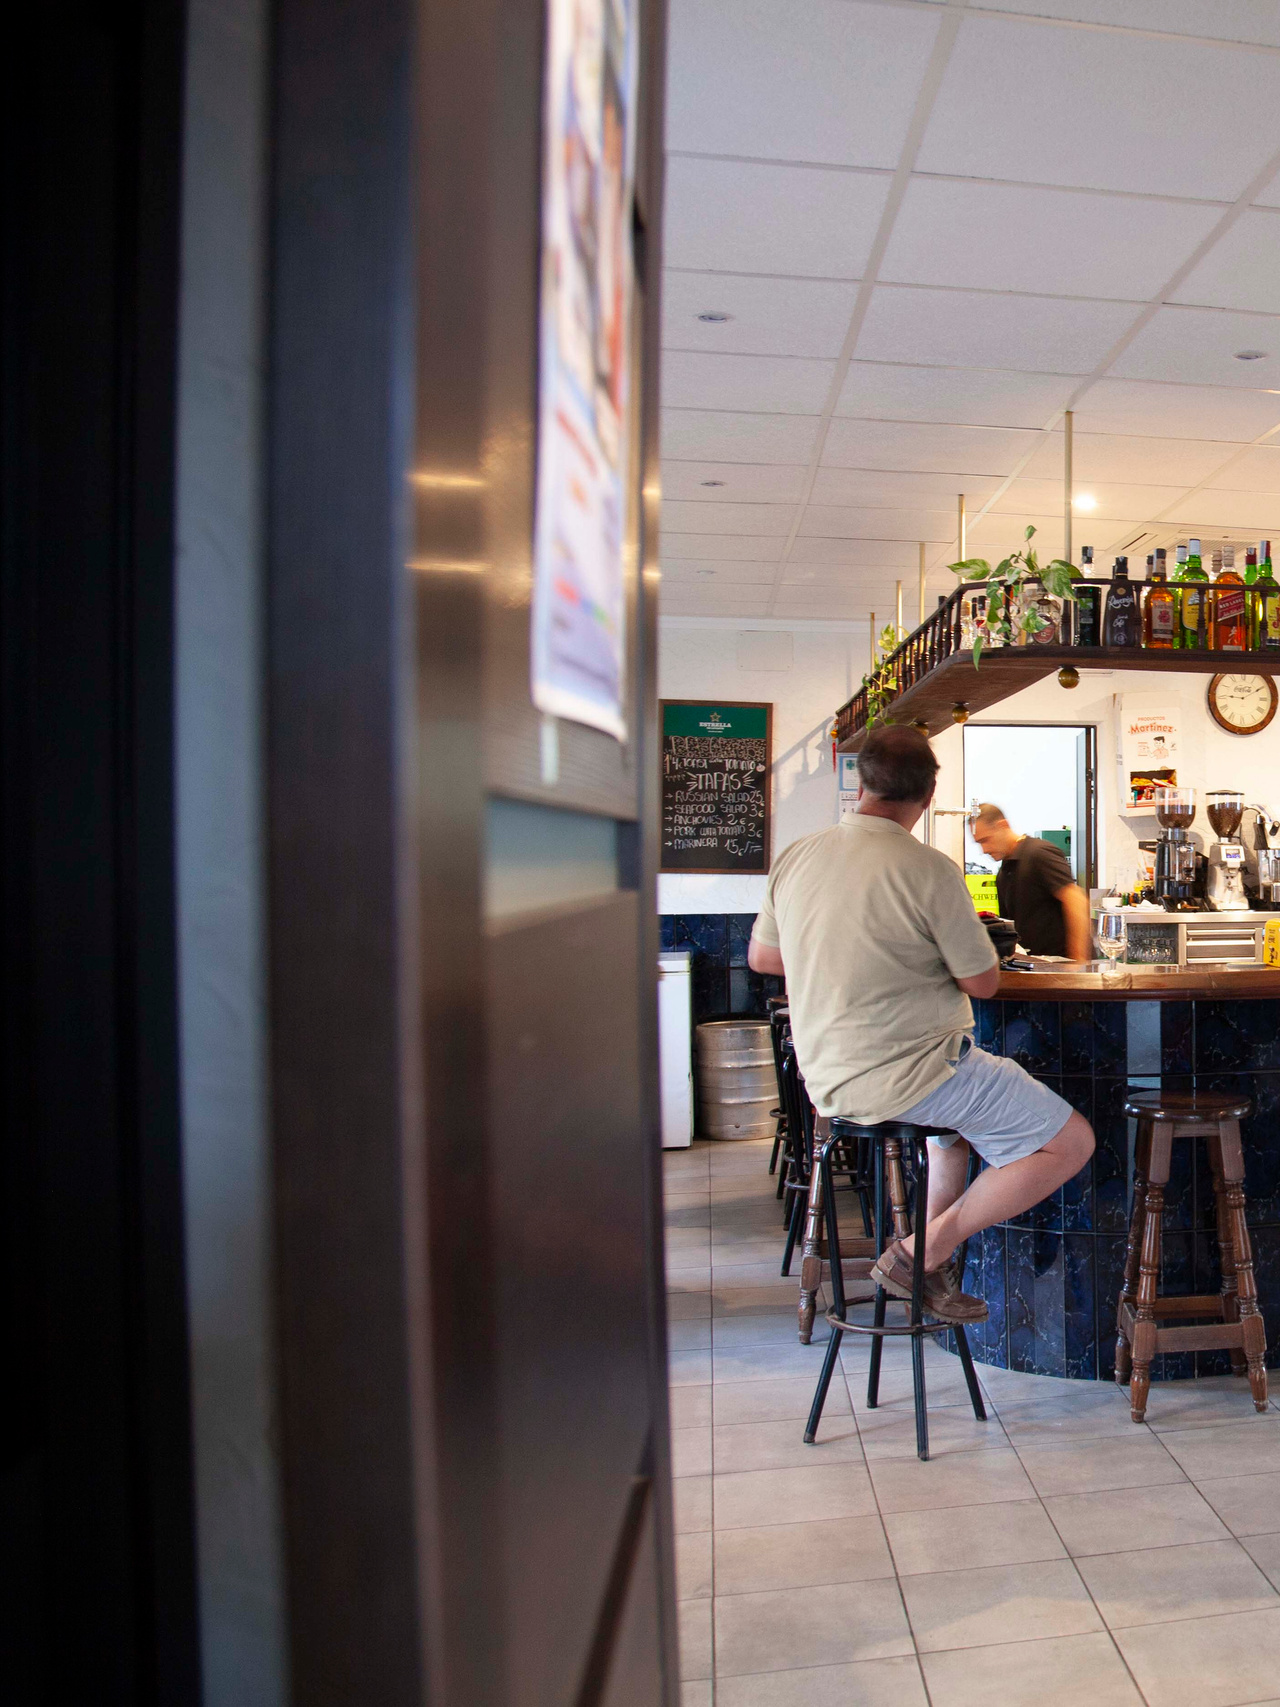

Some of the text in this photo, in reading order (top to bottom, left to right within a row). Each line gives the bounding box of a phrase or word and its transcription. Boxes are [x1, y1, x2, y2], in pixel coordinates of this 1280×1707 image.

[695, 771, 742, 792] TAPAS
[675, 790, 719, 803] RUSSIAN
[721, 792, 750, 803] SALAD
[674, 803, 716, 815] SEAFOOD
[720, 804, 748, 814] SALAD
[674, 814, 722, 825] ANCHOVIES
[674, 825, 696, 836] PORK
[717, 825, 746, 836] TOMATO
[674, 838, 718, 849] MARINERA
